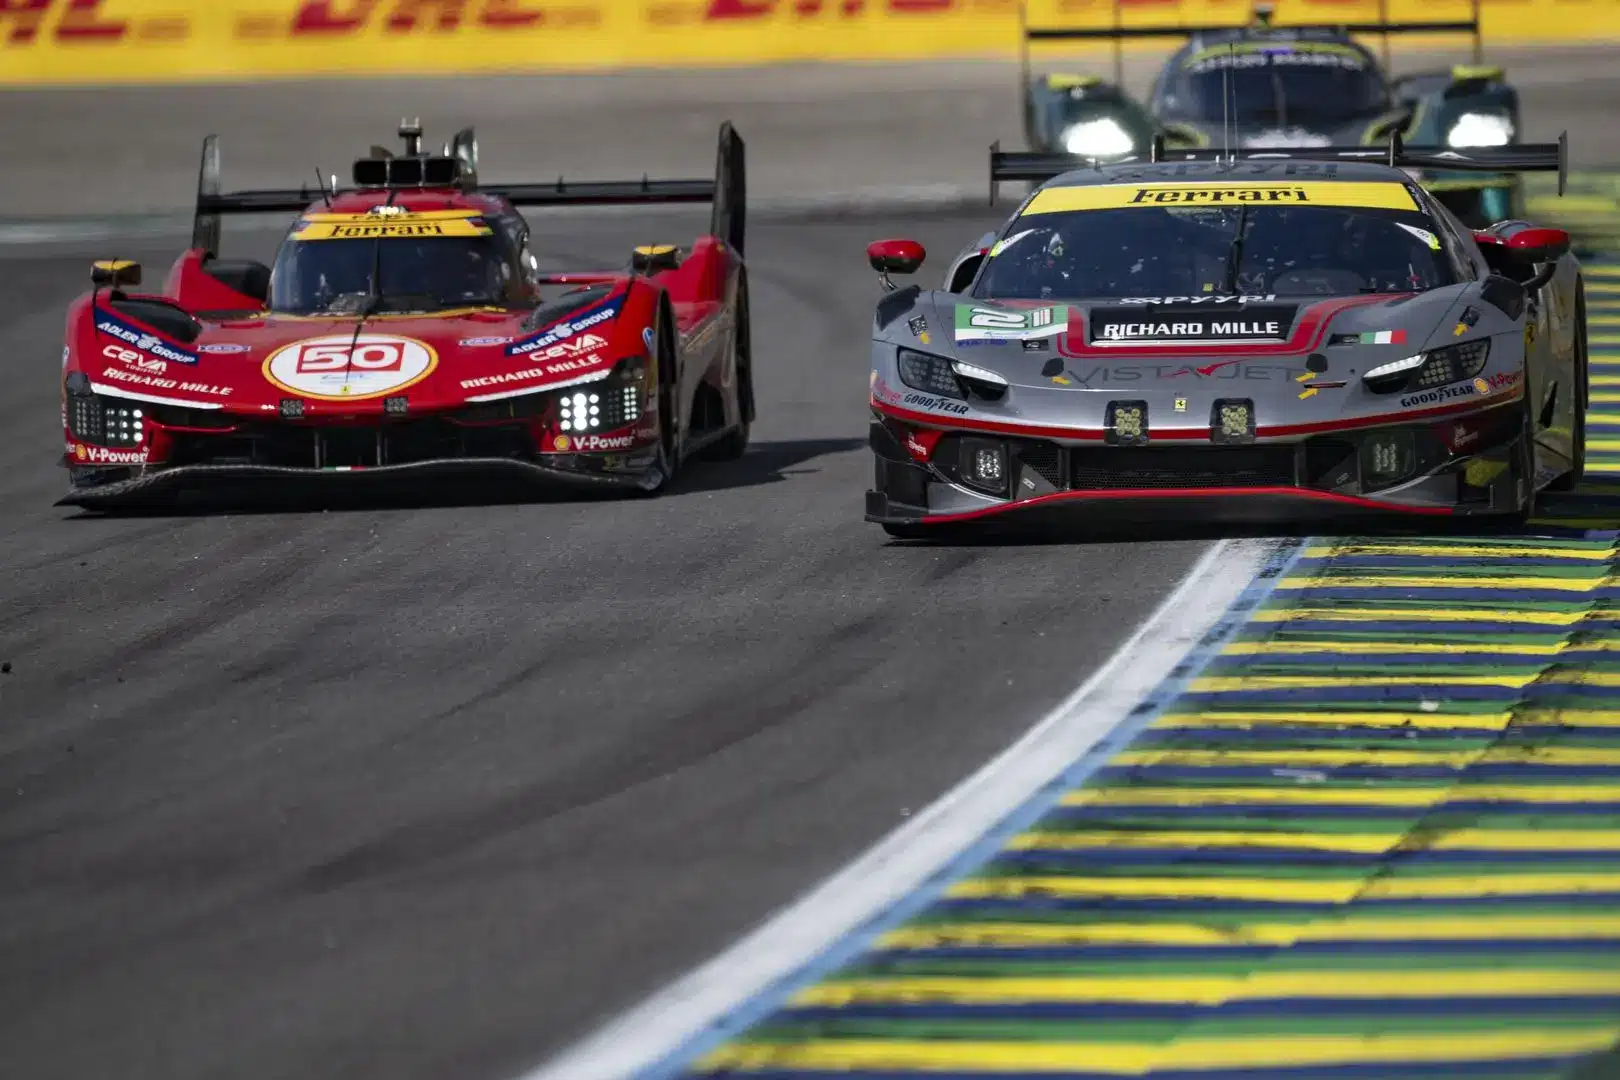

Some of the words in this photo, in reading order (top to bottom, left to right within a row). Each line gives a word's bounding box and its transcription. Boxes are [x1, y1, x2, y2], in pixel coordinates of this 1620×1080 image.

[1127, 187, 1311, 204] Ferrari
[328, 223, 444, 237] Ferrari
[512, 332, 559, 355] ADLER
[571, 308, 615, 331] GROUP
[1104, 323, 1203, 337] RICHARD
[1211, 322, 1280, 334] MILLE
[97, 322, 139, 344] ADLER
[150, 346, 196, 363] GROUP
[300, 344, 400, 370] 50
[103, 367, 177, 388] RICHARD
[179, 381, 234, 396] MILLE
[459, 368, 544, 389] RICHARD
[547, 354, 602, 374] MILLE
[904, 394, 970, 415] GOODYEAR
[1401, 386, 1475, 408] GOODYEAR
[573, 436, 634, 450] V-Power
[87, 448, 146, 463] V-Power
